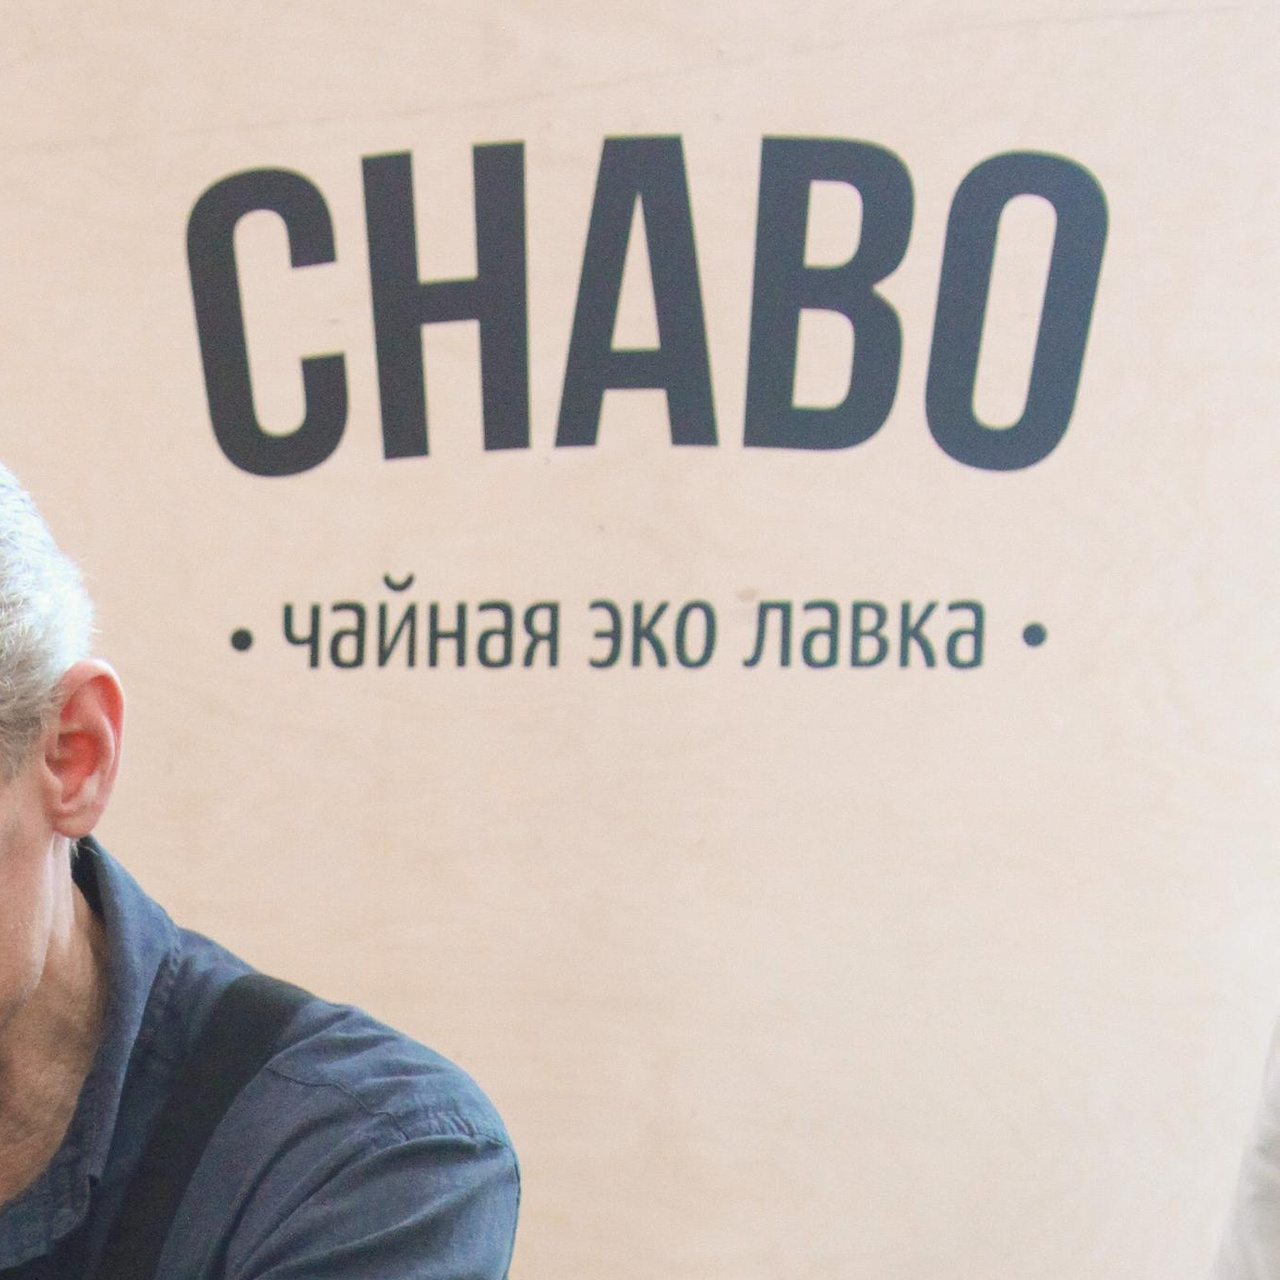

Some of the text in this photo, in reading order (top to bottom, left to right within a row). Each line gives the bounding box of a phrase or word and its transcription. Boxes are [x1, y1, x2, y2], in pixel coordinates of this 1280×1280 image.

[186, 134, 1110, 477] CHABO
[282, 572, 984, 669] чайная эко лавка
